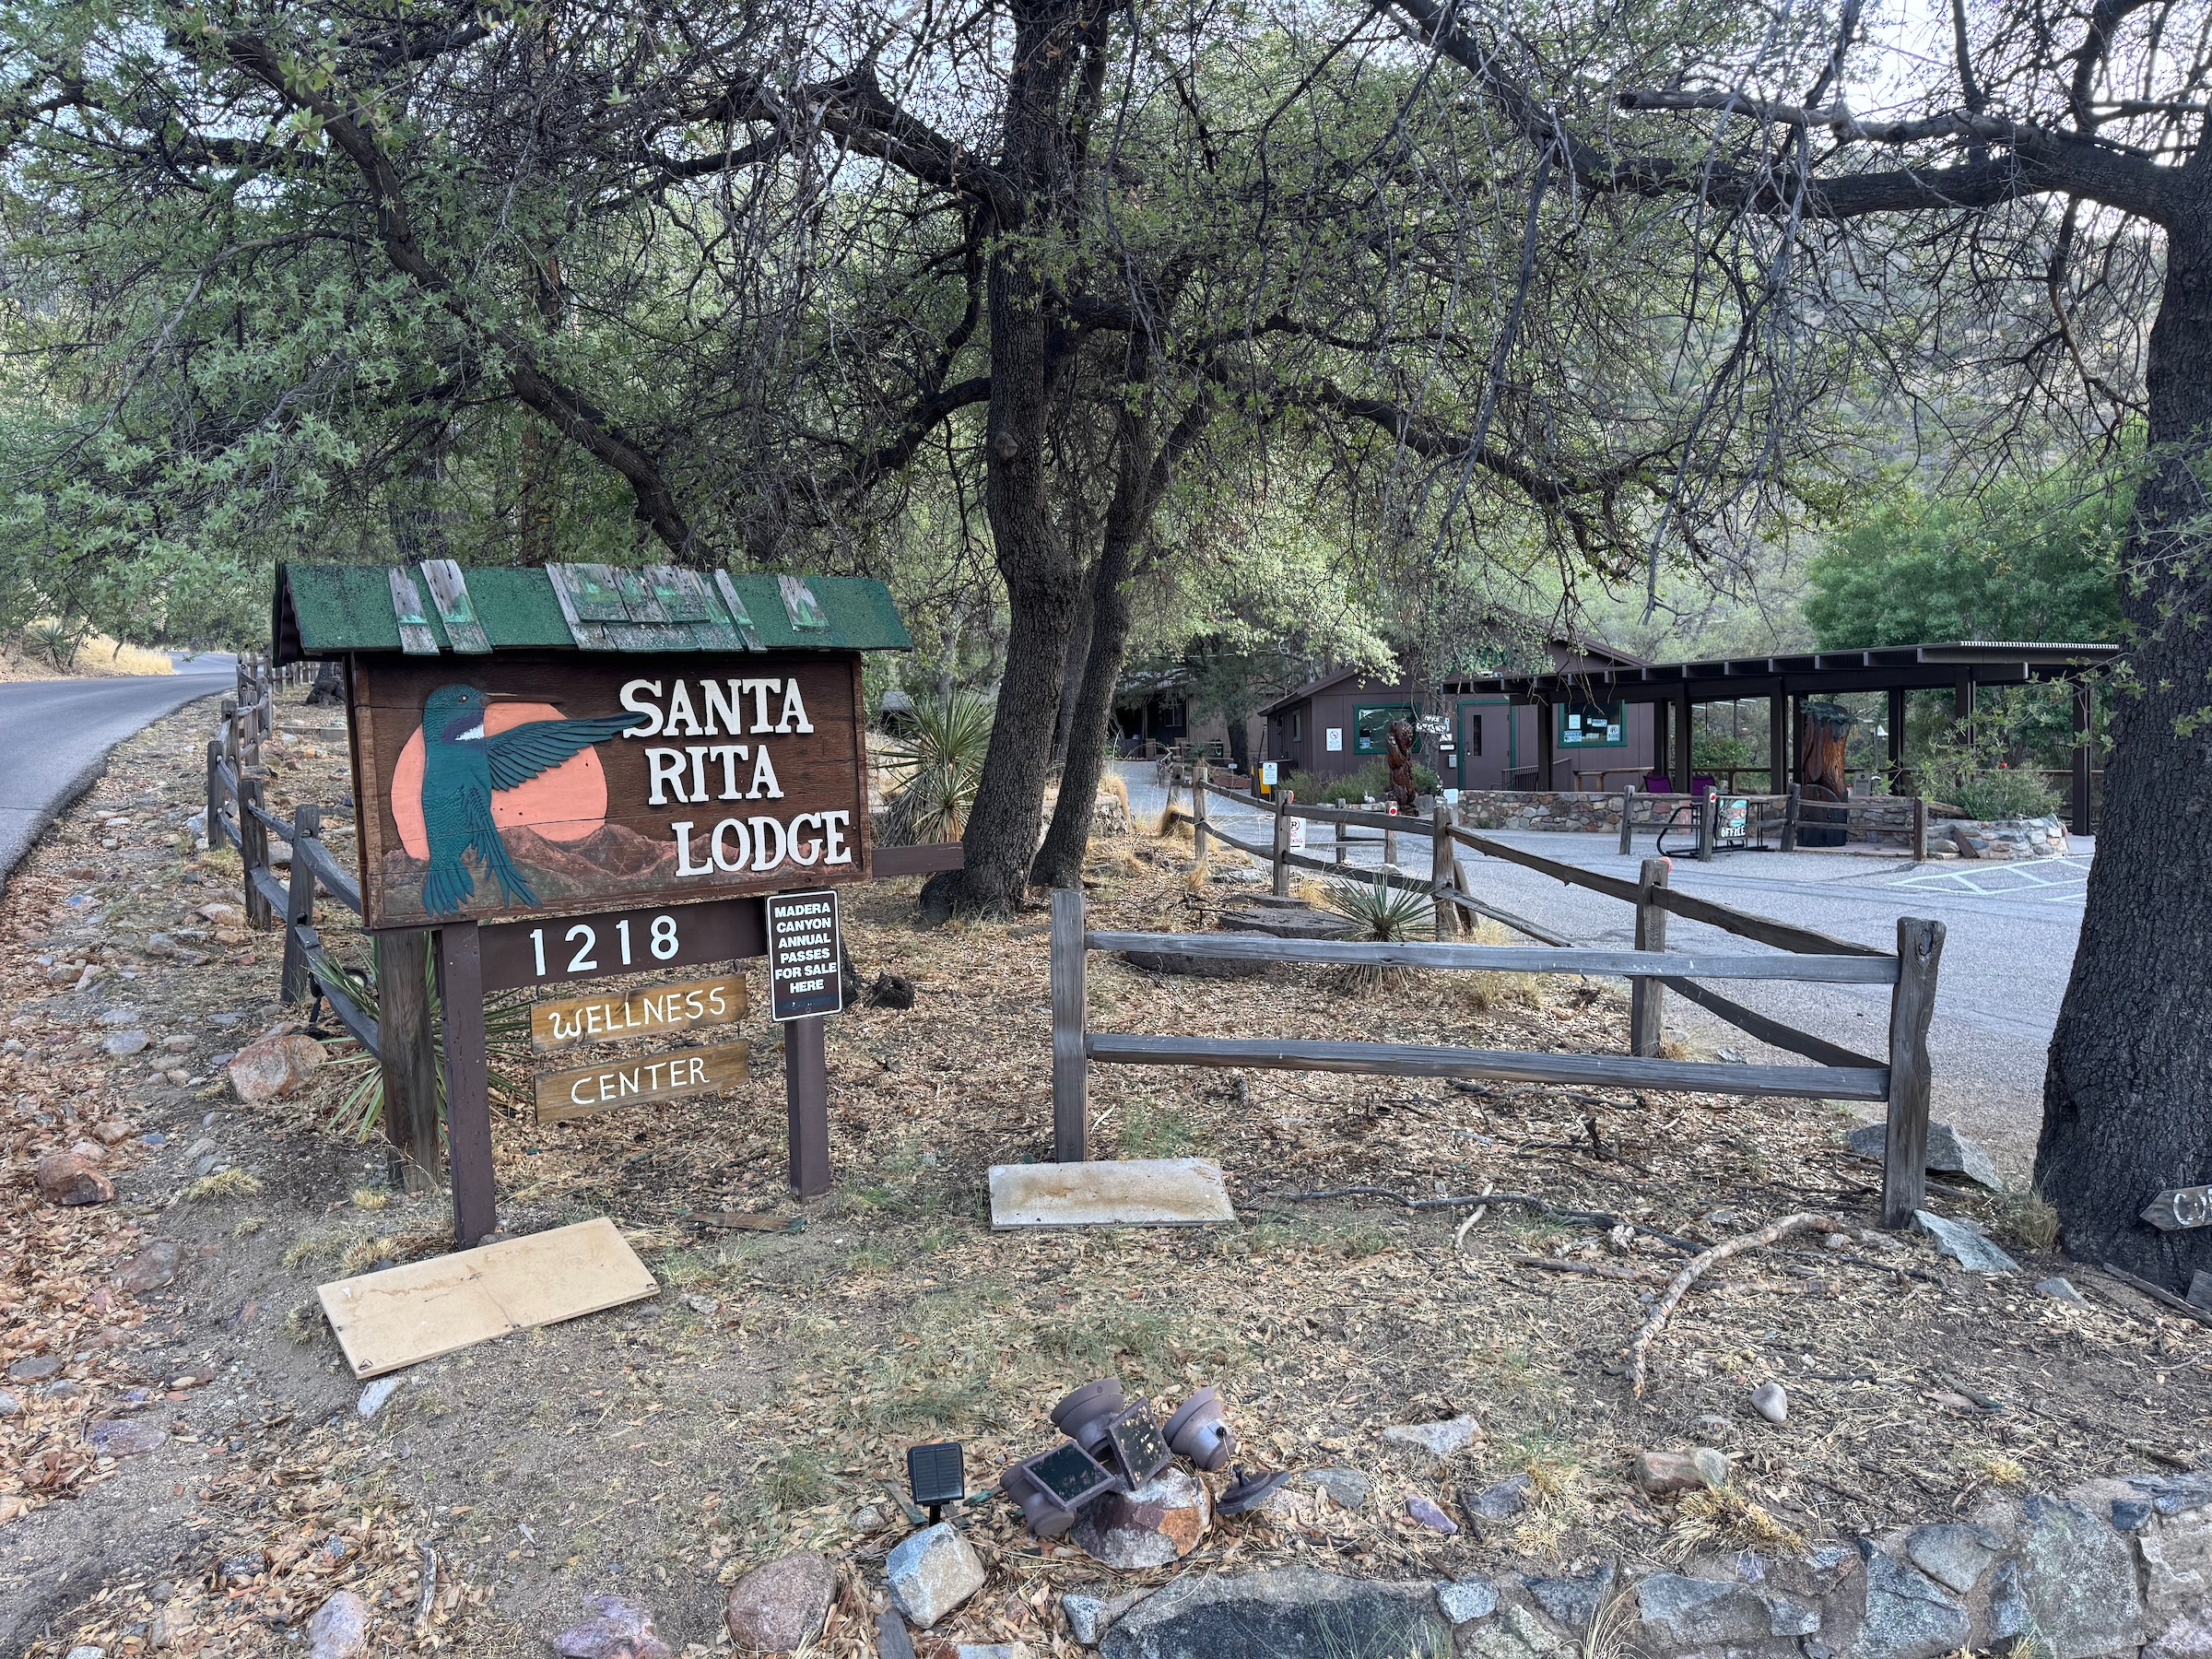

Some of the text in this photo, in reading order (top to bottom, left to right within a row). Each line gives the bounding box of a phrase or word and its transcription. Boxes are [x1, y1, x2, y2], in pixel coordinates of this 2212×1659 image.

[619, 677, 814, 738] SANTA
[645, 745, 784, 806] RITA
[1721, 825, 1746, 838] OFFICE
[671, 810, 852, 877] LODGE
[774, 902, 831, 919] MADERA
[776, 917, 832, 934] CANYON
[529, 915, 679, 976] 1218
[778, 933, 832, 949] ANNUAL
[780, 947, 830, 964] PASSES
[774, 961, 838, 981] FOR SALE
[789, 979, 825, 994] HERE
[547, 986, 726, 1040] WELLNESS
[571, 1057, 710, 1105] CENTER
